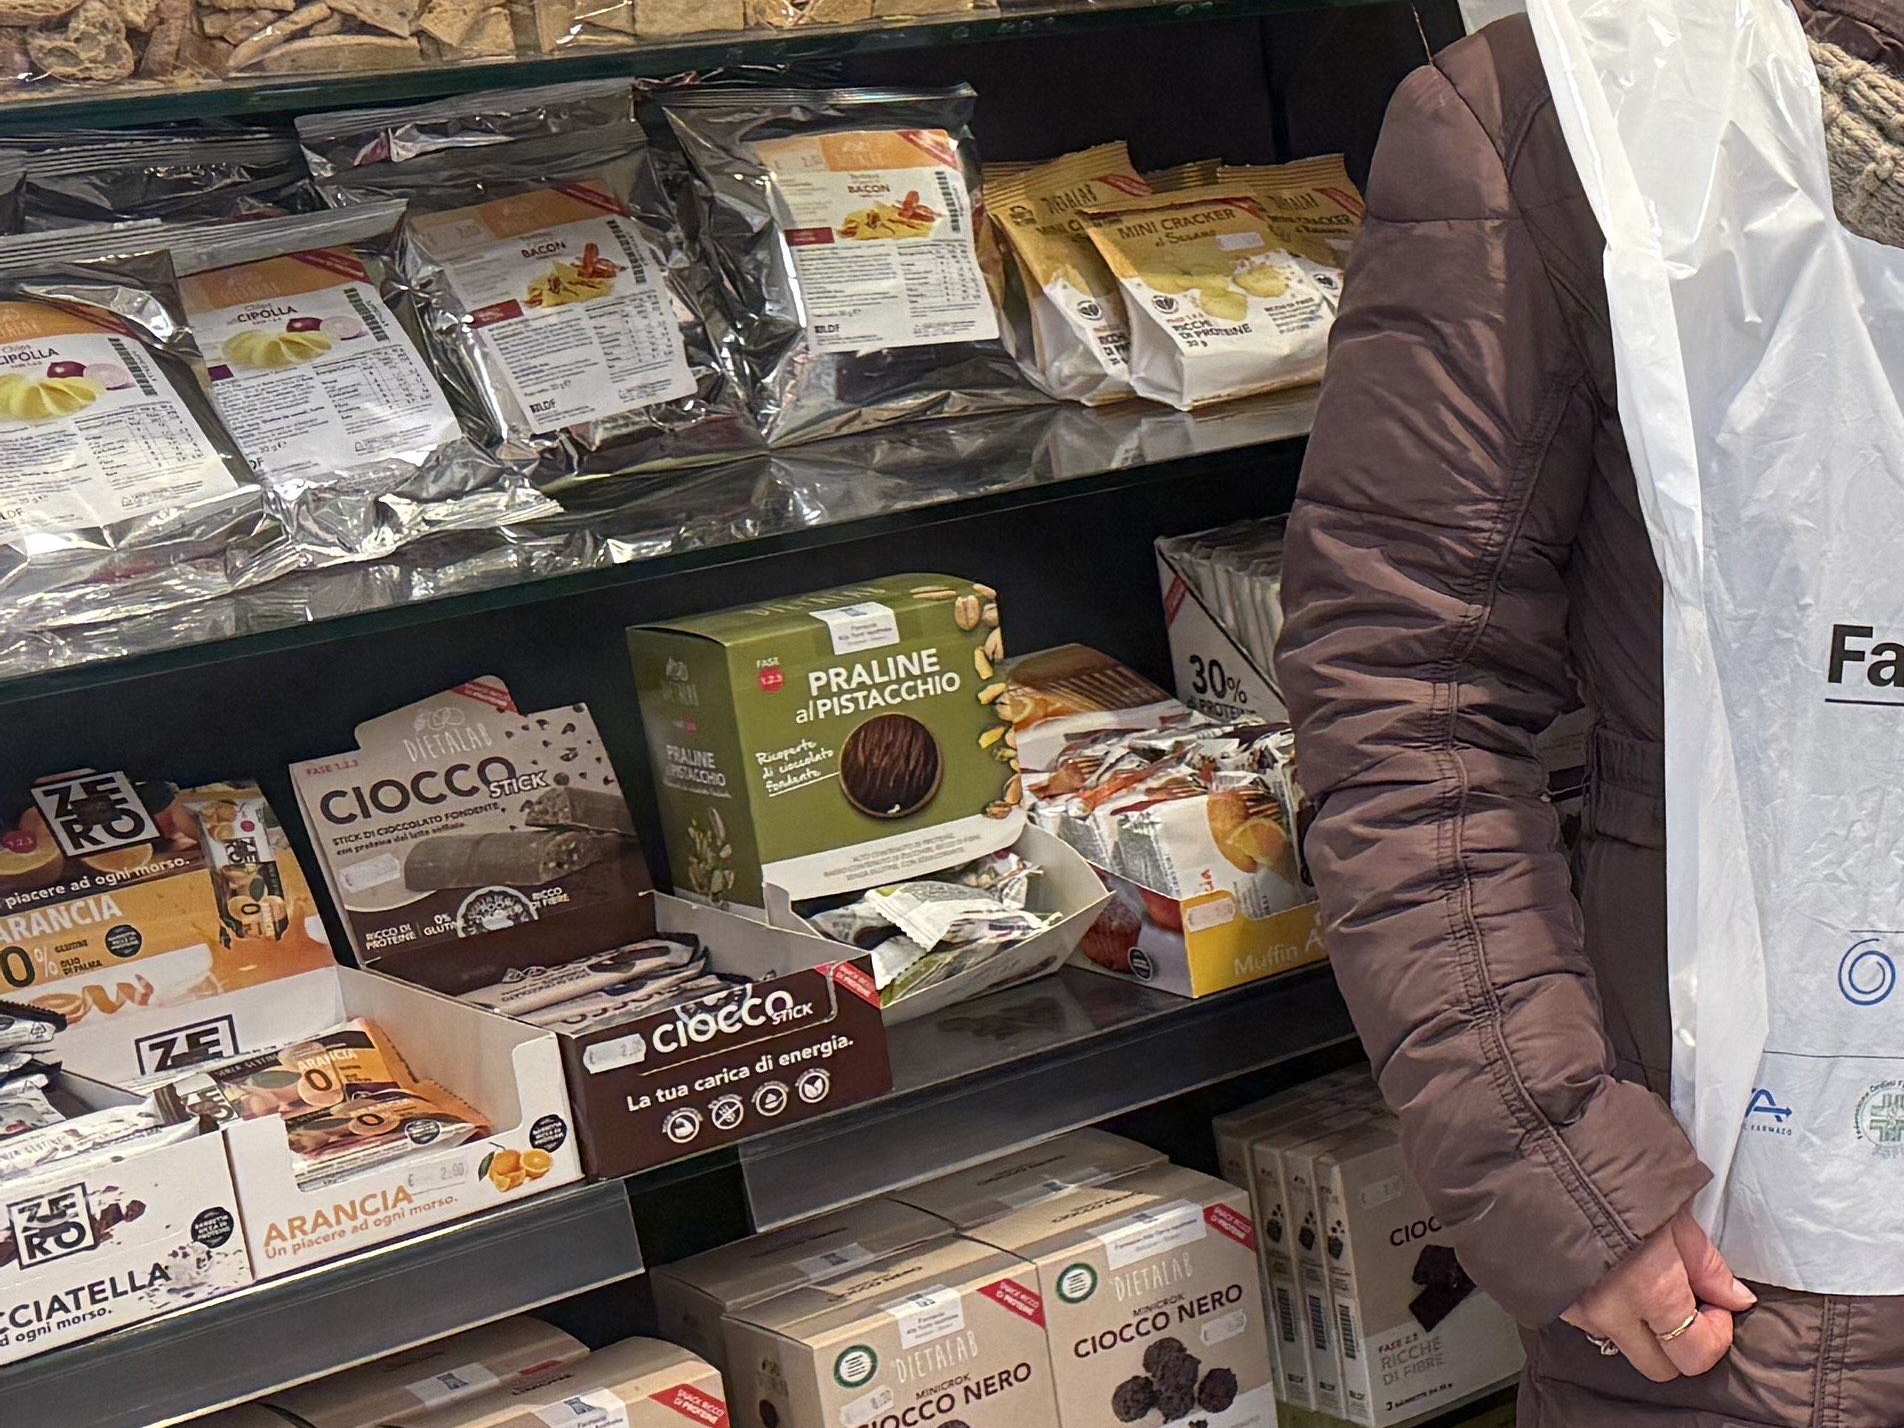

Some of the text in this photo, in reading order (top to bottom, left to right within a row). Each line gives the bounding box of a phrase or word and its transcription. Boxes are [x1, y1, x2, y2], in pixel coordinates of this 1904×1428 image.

[1118, 208, 1236, 241] MINI CRACKER
[236, 305, 297, 323] CIPOLLA
[794, 671, 961, 724] al PISTACCHIO
[808, 648, 941, 697] PRALINE
[403, 719, 493, 763] DIETALAB
[318, 757, 516, 825] CIOCCO
[488, 771, 548, 799] STICK
[652, 990, 793, 1054] CIOCCO
[627, 1034, 854, 1111] La tua carica di energia.
[263, 1186, 413, 1248] ARANCIA
[1073, 1283, 1244, 1360] CIOCCO NERO
